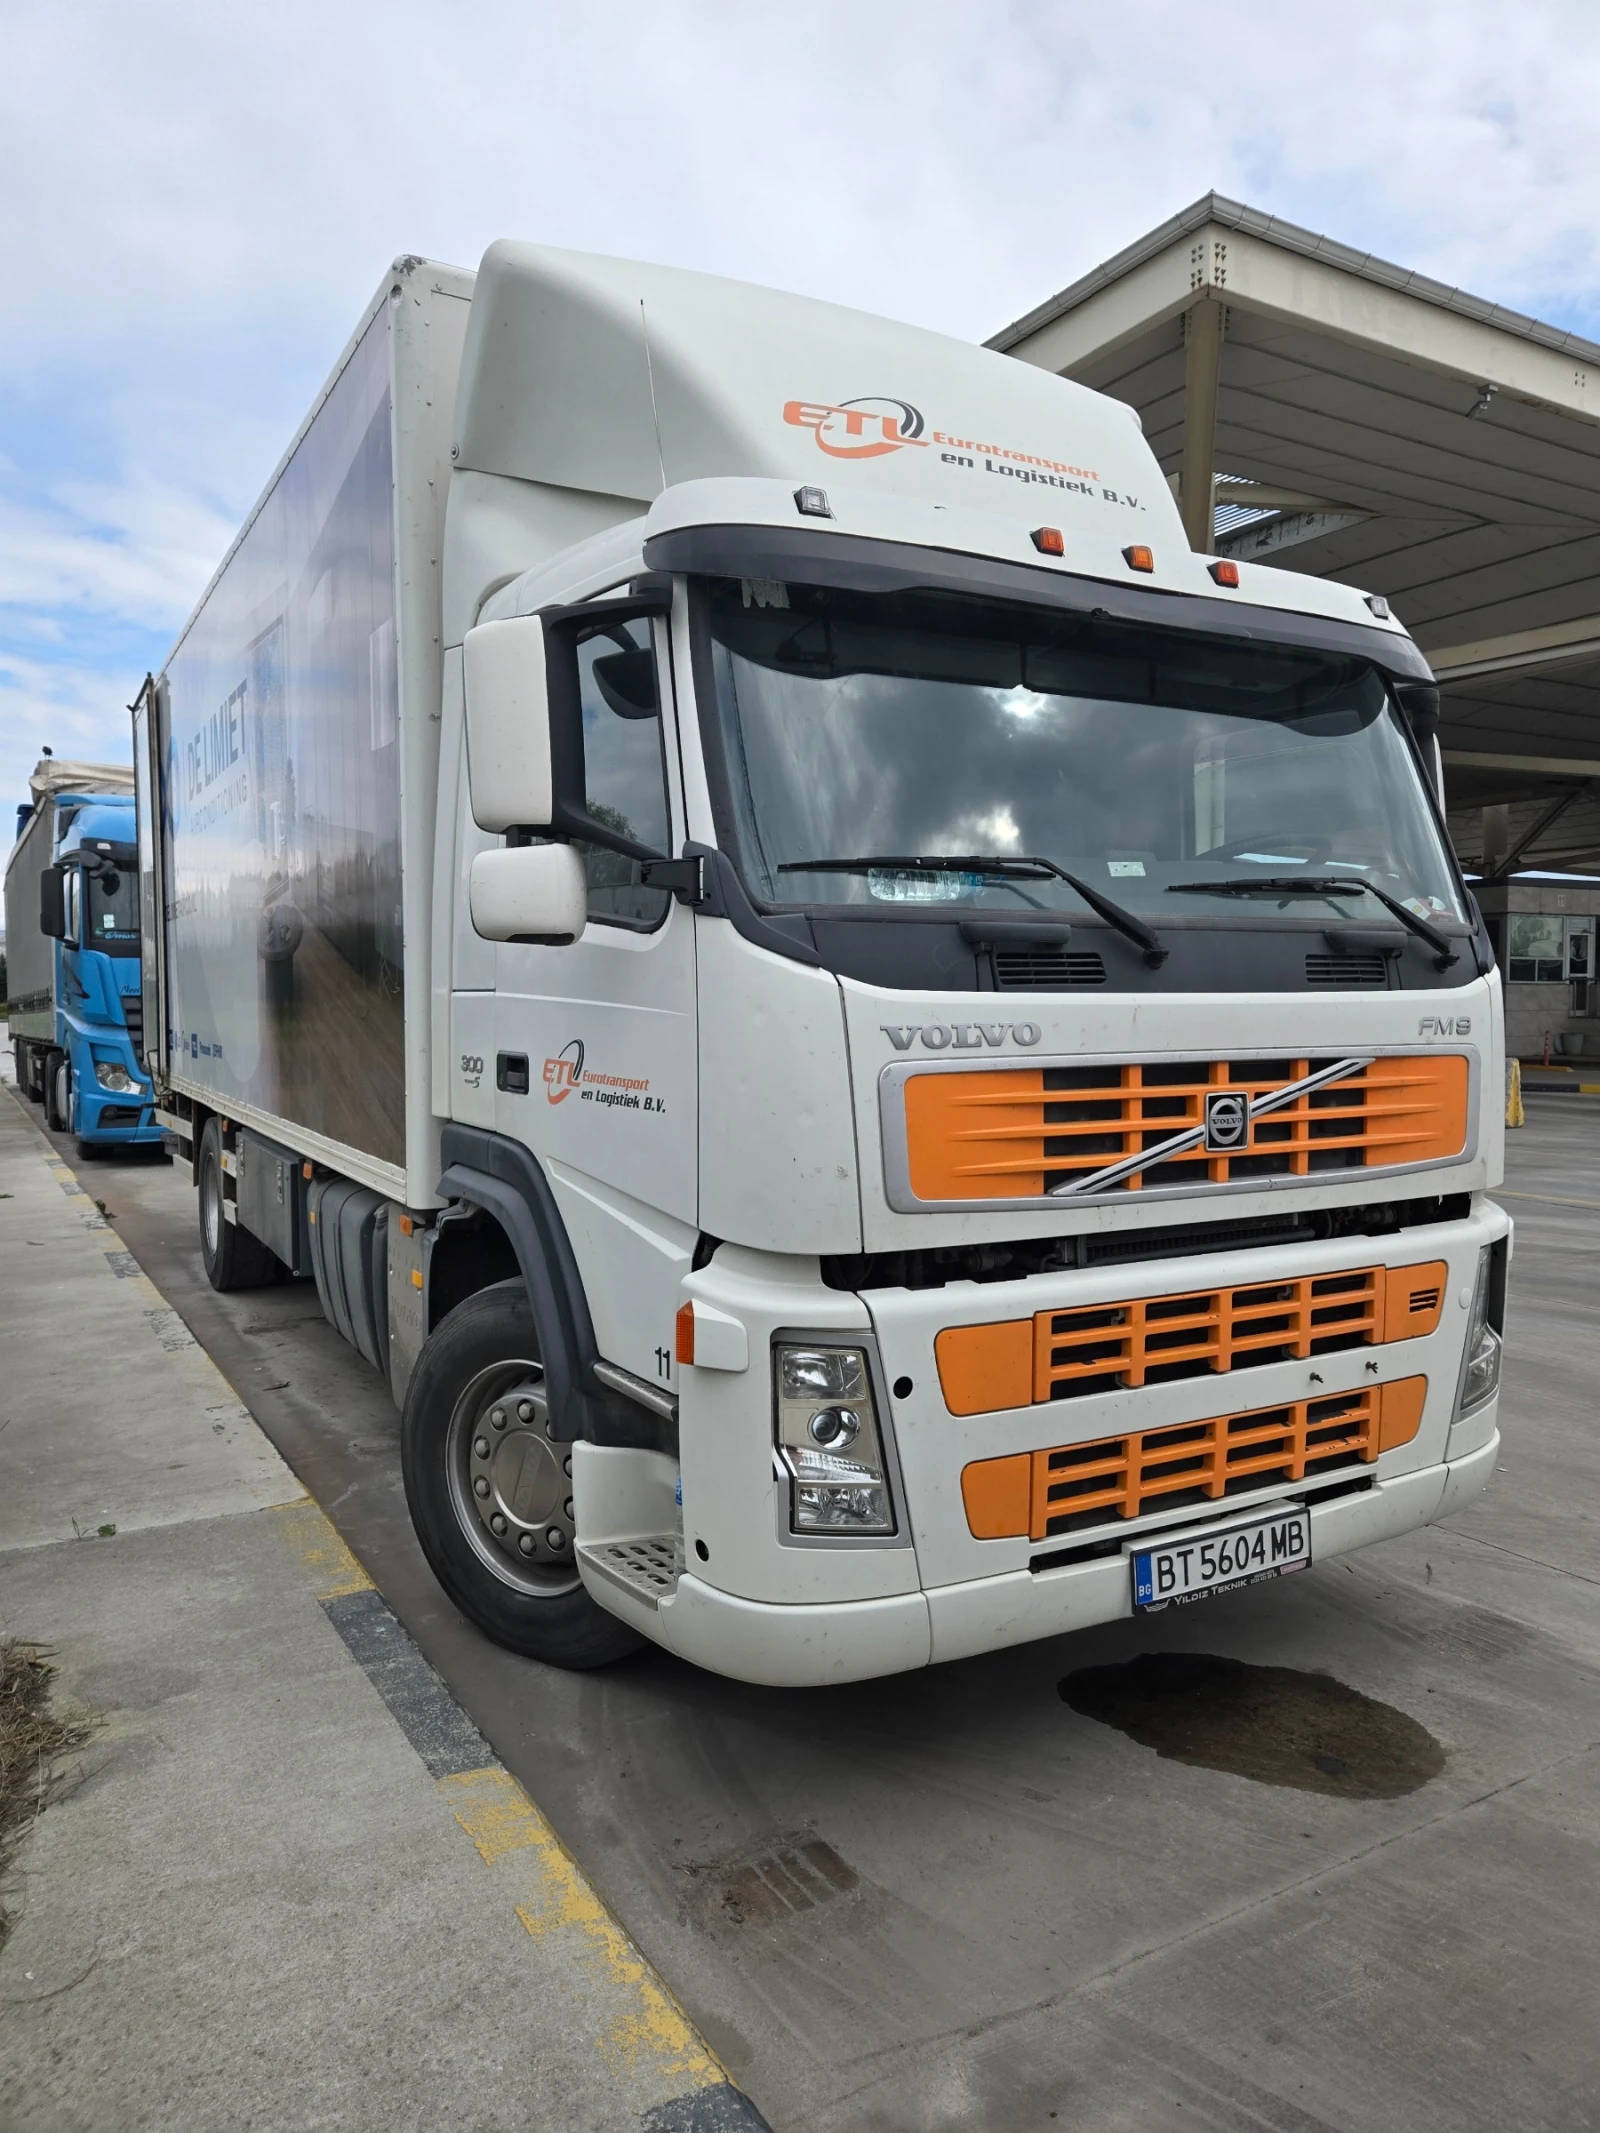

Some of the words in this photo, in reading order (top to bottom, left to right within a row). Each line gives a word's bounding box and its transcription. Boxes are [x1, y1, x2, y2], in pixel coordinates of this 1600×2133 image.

[783, 399, 931, 448] ETL
[932, 430, 1101, 482] Eurotransport
[940, 450, 974, 468] en
[985, 459, 1095, 497] Logistiek
[1102, 487, 1146, 511] B.V.
[187, 730, 203, 803] DE
[203, 677, 248, 788] LIMIET
[880, 1021, 1042, 1050] VOLVO
[1417, 1016, 1472, 1036] FM9
[461, 1055, 484, 1075] 300
[542, 1058, 581, 1088] ETL
[582, 1069, 650, 1092] Eurotransport
[581, 1090, 593, 1101] en
[595, 1090, 640, 1109] Logistiek
[643, 1097, 666, 1113] B.V.
[1212, 1115, 1243, 1128] VOLVO
[654, 1346, 671, 1380] 11
[1156, 1548, 1194, 1594] BT
[1200, 1530, 1266, 1581] 5604
[1271, 1520, 1304, 1562] MB
[1138, 1584, 1152, 1597] BG
[1173, 1590, 1209, 1606] YILDIZ
